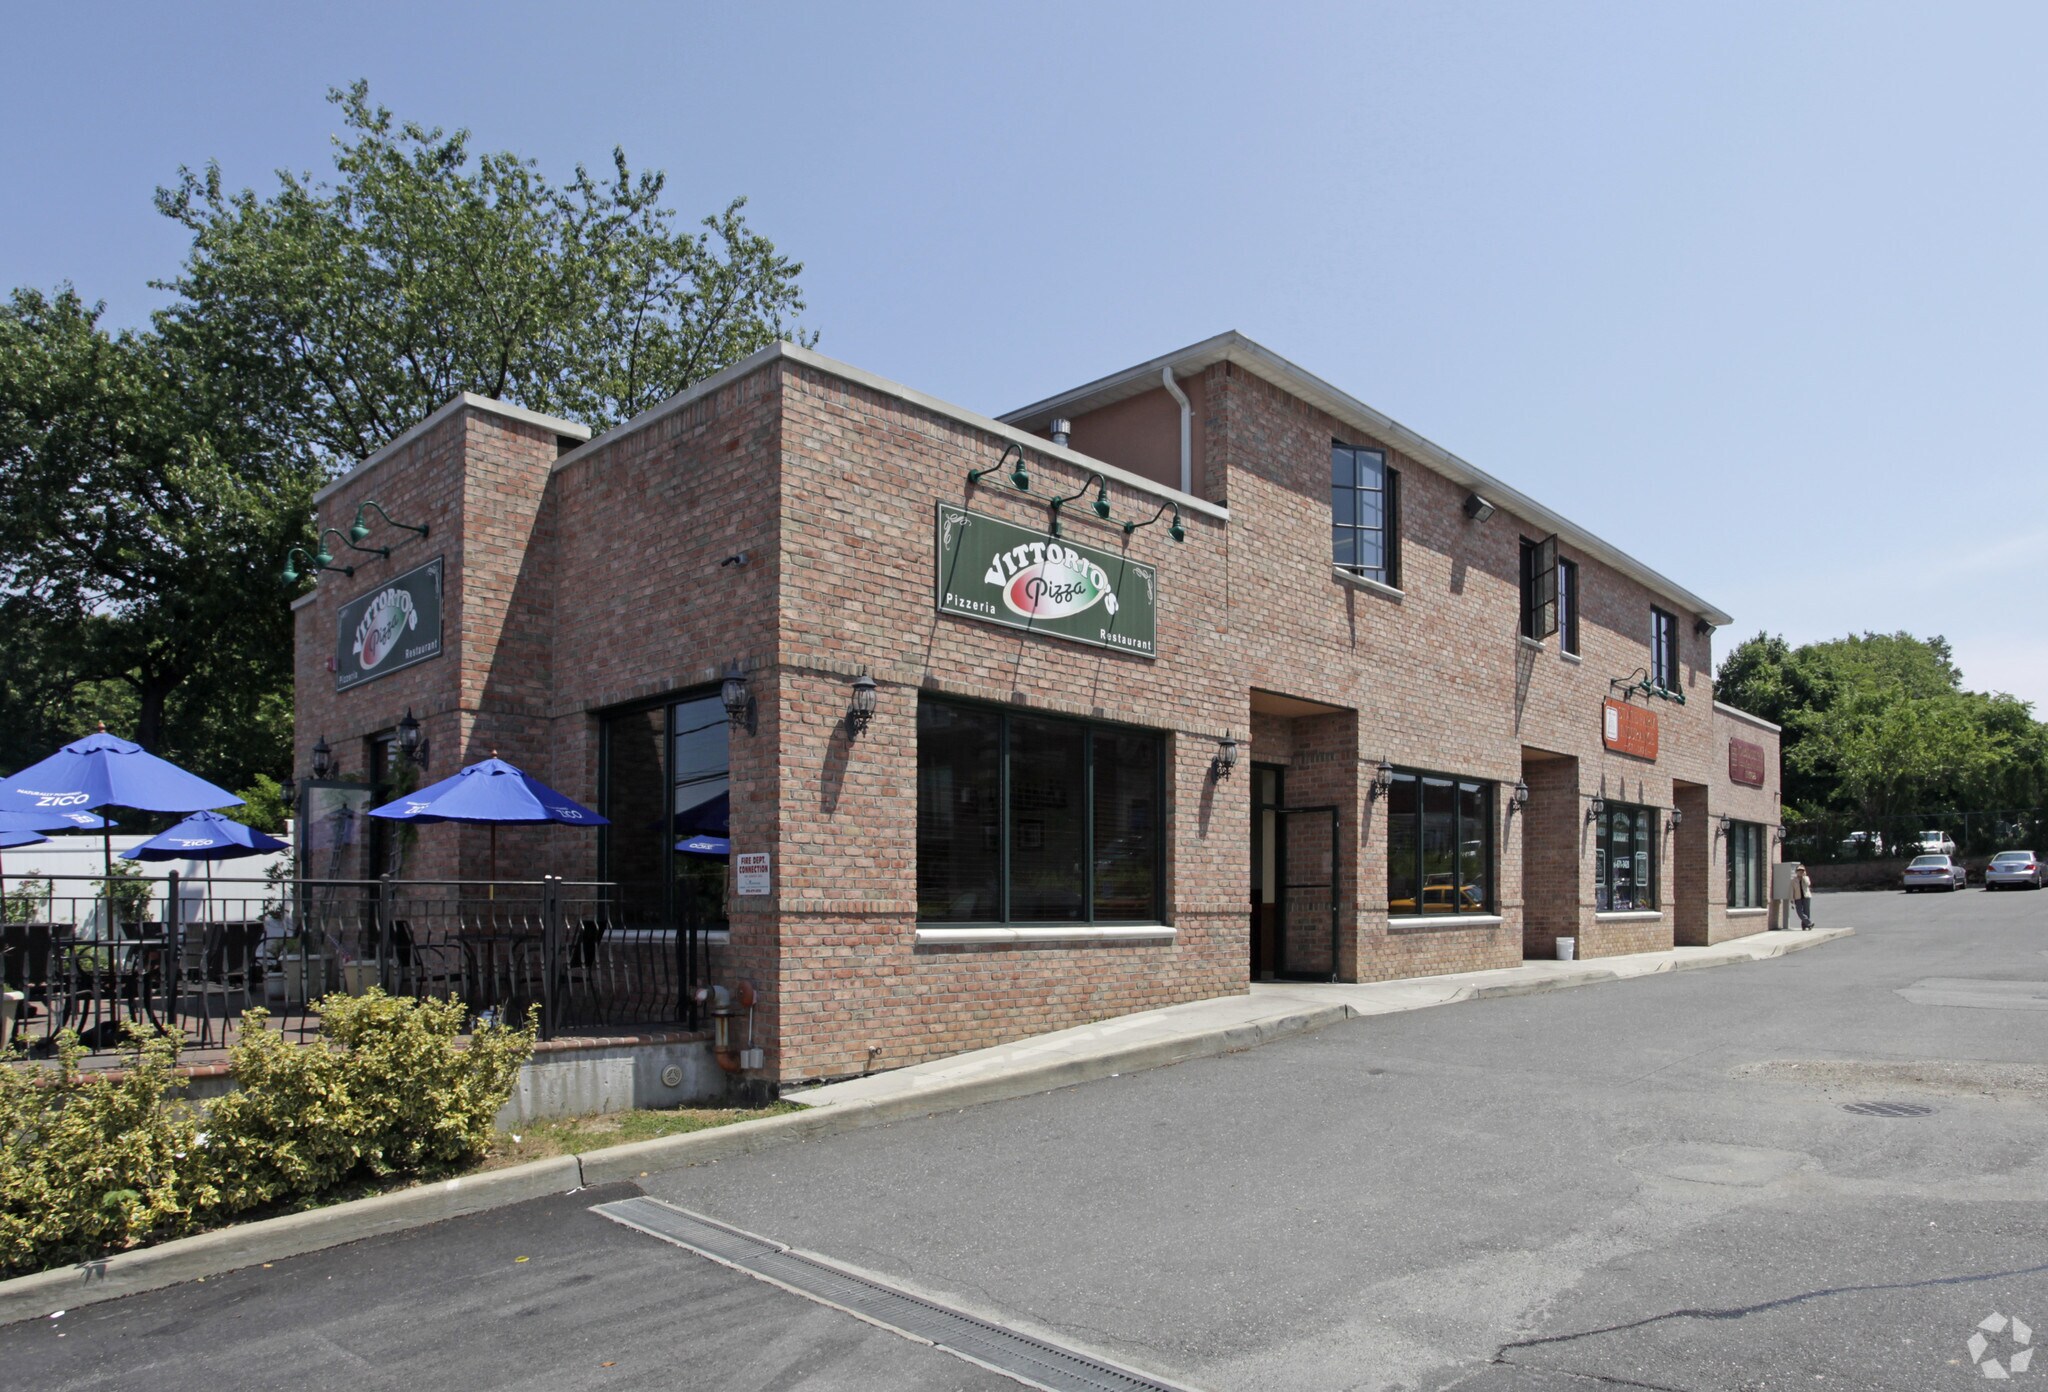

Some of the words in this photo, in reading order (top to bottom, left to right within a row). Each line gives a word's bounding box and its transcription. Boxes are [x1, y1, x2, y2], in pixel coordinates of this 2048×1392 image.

[984, 541, 1120, 616] VITTORIO'S
[1025, 576, 1087, 608] Pizza
[946, 592, 996, 615] Pizzeria
[405, 639, 438, 659] Restaurant
[1100, 628, 1152, 651] Restaurant
[35, 793, 90, 806] ZICO
[182, 839, 214, 847] ZICO
[739, 864, 769, 874] CONNECTION
[740, 856, 752, 865] FIRE
